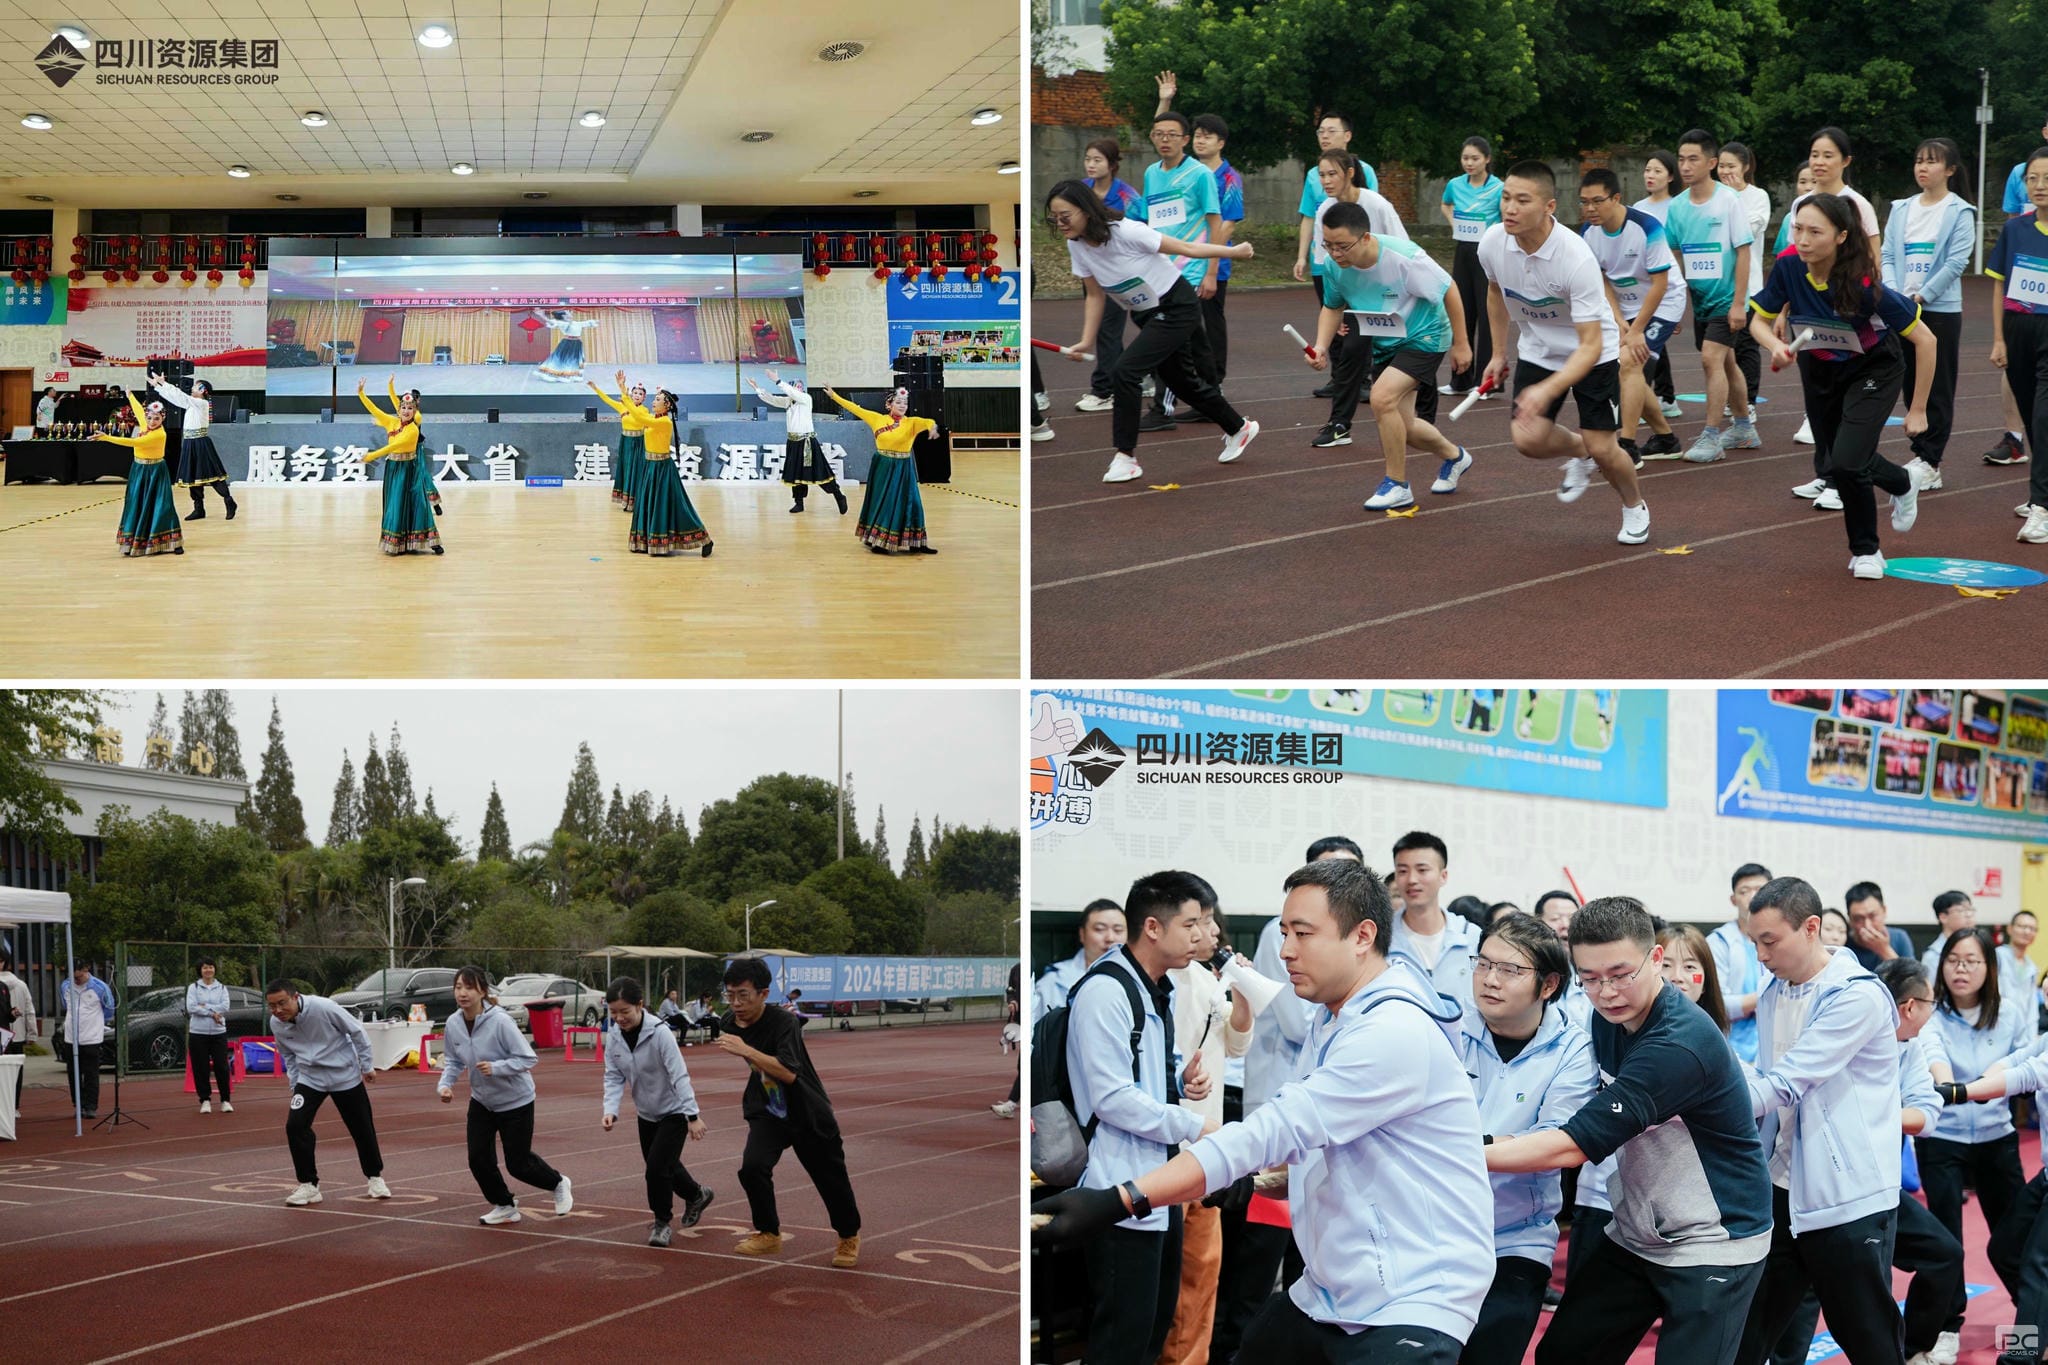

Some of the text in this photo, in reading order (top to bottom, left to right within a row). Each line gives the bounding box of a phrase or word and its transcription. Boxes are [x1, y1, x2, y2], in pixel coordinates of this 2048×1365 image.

[1155, 206, 1178, 219] 0098
[1692, 260, 1716, 270] 0025
[920, 282, 983, 294] 四川资源集团
[997, 275, 1019, 305] 2
[2020, 279, 2048, 295] 000
[1366, 316, 1396, 327] 0021
[843, 964, 976, 993] 2024年首届职工运动会
